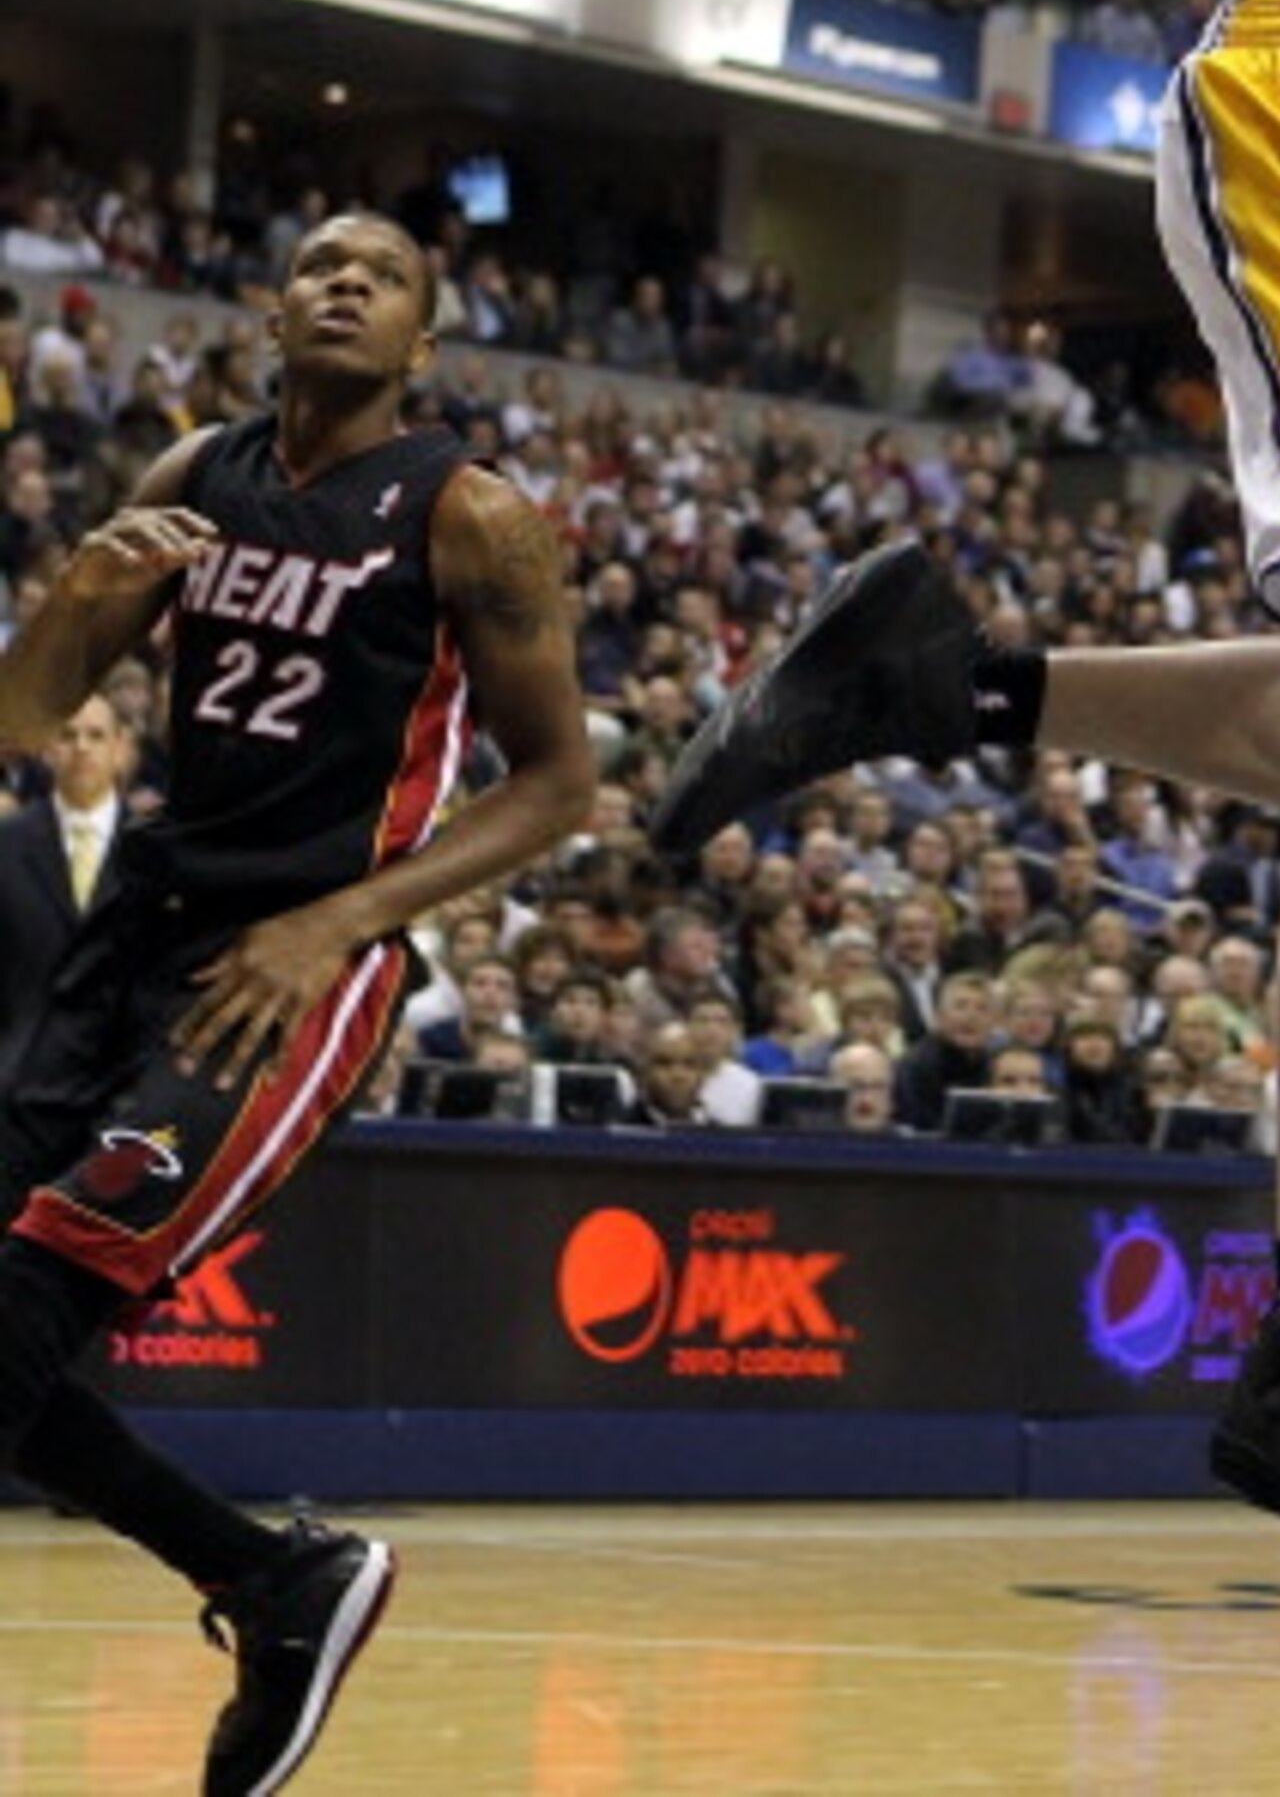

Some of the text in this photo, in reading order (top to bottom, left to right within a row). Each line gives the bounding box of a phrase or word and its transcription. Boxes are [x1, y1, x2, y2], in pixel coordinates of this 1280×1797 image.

[181, 544, 394, 637] HEAT
[195, 640, 326, 741] 22
[674, 1249, 847, 1341] MAX
